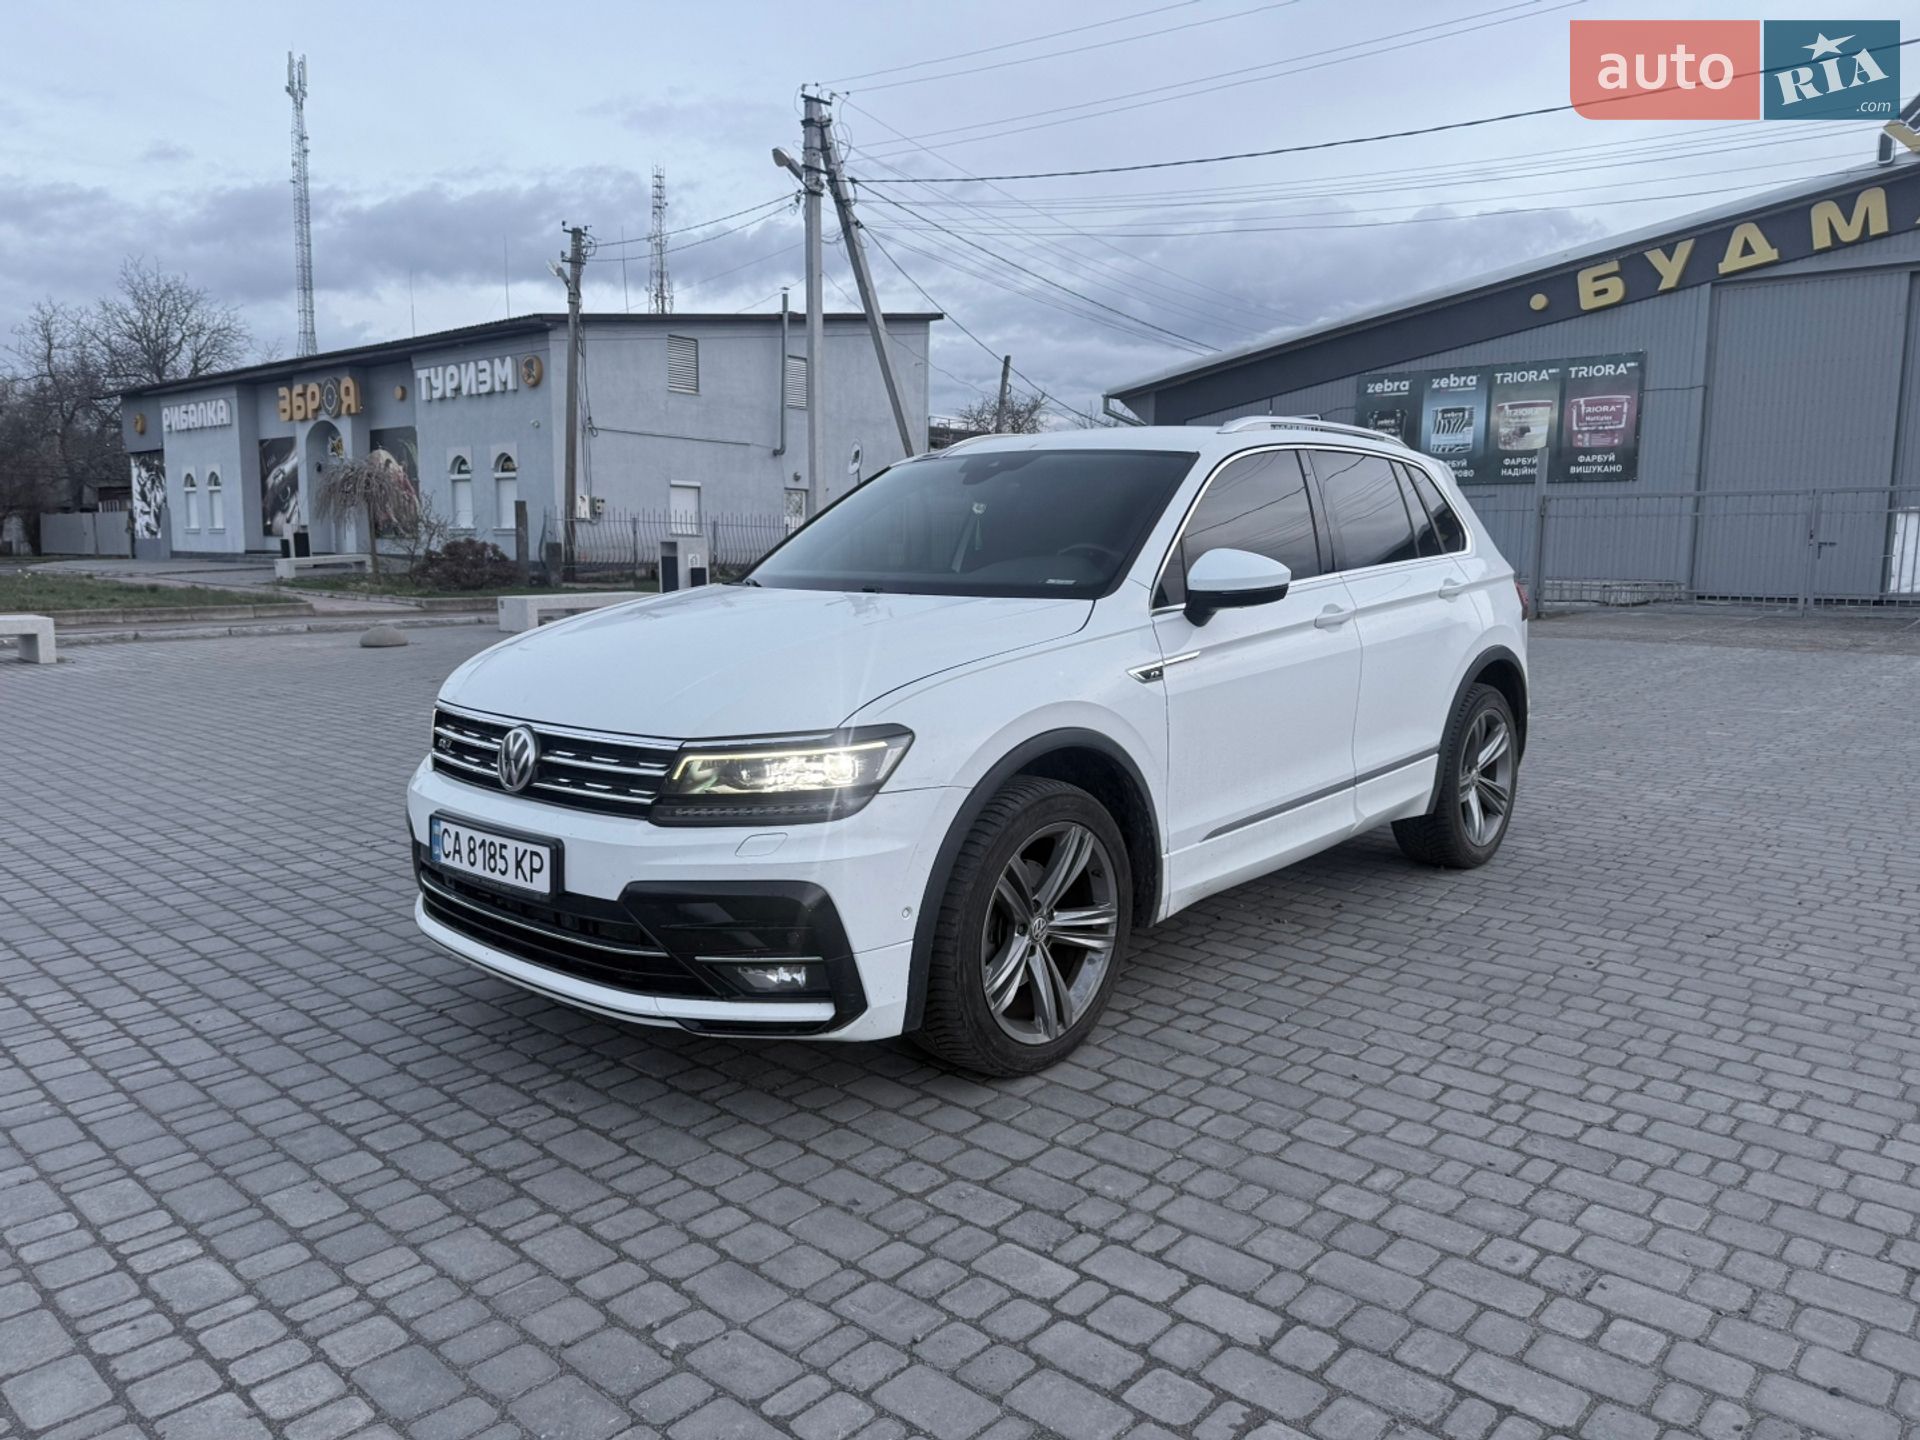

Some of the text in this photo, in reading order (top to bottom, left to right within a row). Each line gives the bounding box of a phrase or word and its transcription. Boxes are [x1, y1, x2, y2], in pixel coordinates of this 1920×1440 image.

[1577, 186, 1920, 311] БУДМ
[416, 356, 517, 400] ТУРИЗМ
[1495, 369, 1549, 384] TRIORA
[1568, 362, 1627, 379] TRIORA
[1367, 379, 1410, 394] zebra
[1432, 374, 1477, 389] zebra
[278, 376, 359, 421] ЗБРОЯ
[162, 399, 230, 432] РИБАЛКА
[1577, 453, 1616, 463] ФАРБУЙ
[1569, 465, 1623, 474] ВИШУКАНО
[441, 828, 544, 883] CA 8185 KP
